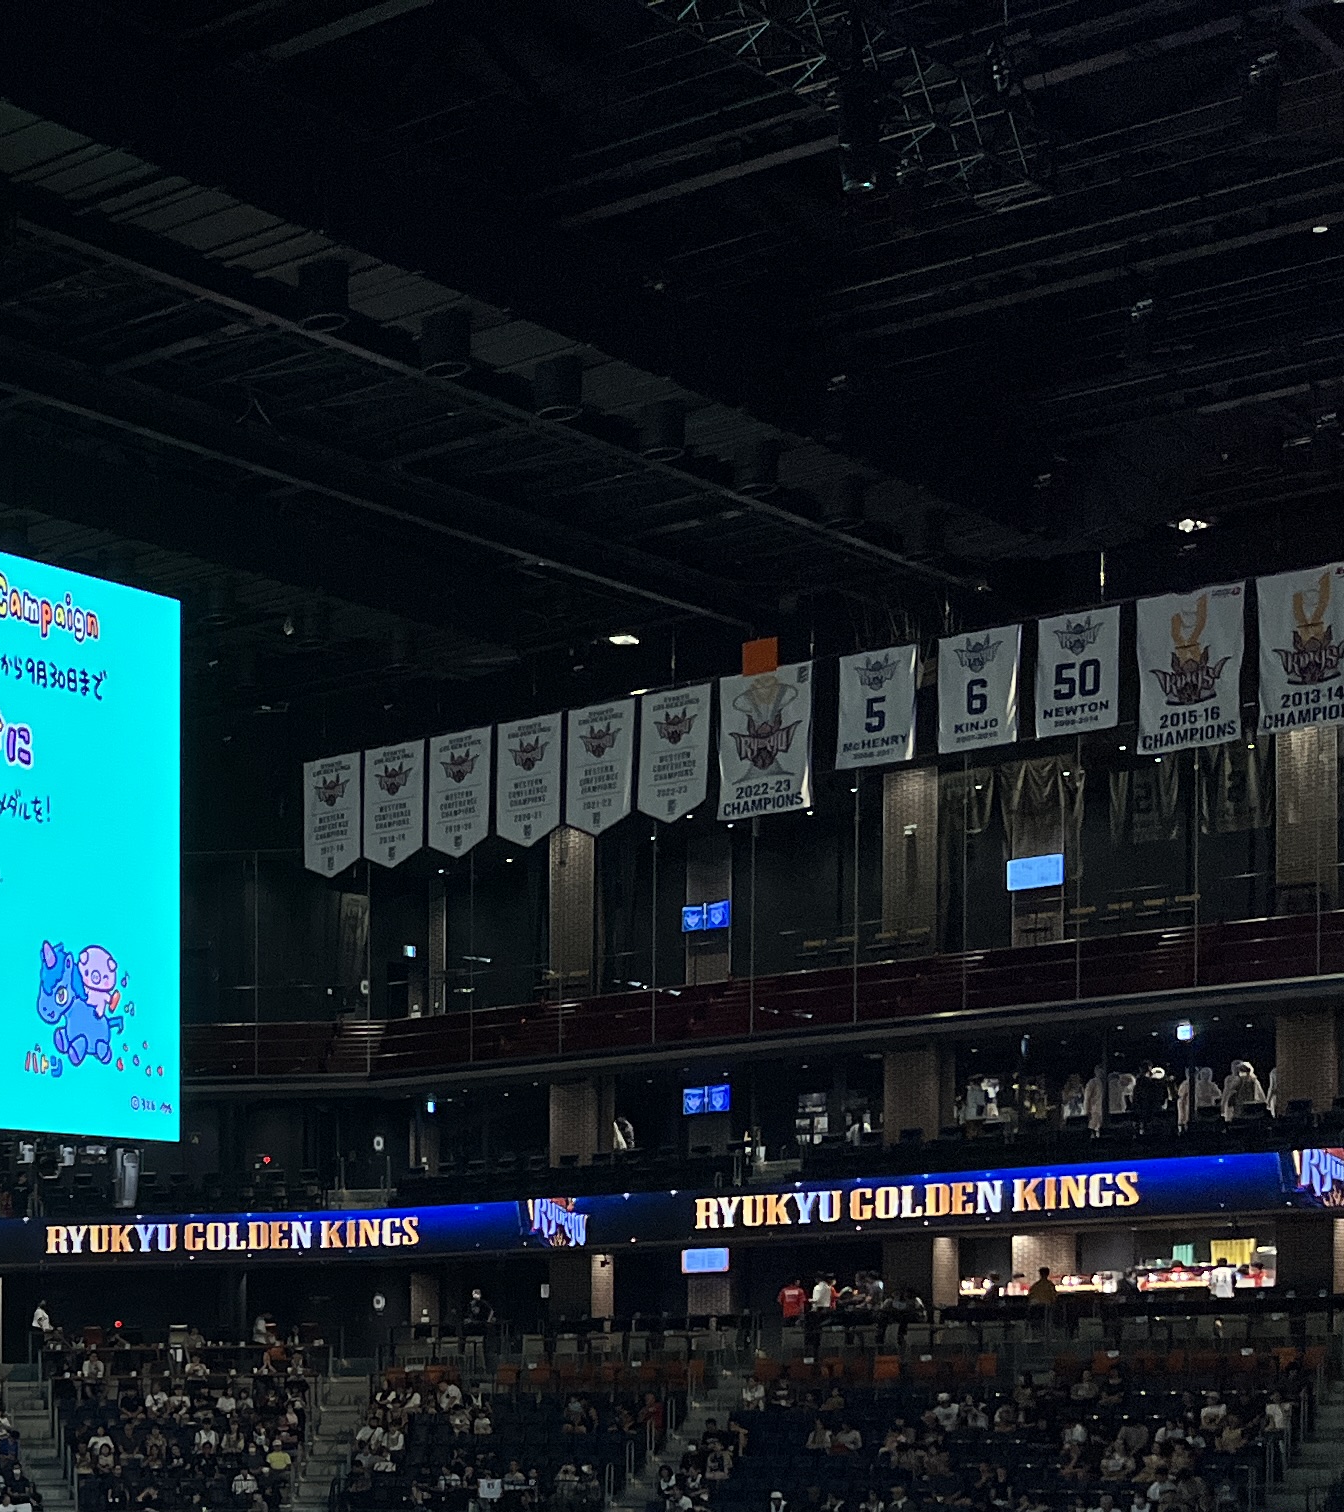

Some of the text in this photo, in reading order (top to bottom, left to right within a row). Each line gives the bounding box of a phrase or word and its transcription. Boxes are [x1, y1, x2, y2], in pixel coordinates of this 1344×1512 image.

[1053, 658, 1101, 701] 50
[966, 678, 988, 716] 6
[1281, 685, 1344, 709] 2013-14
[865, 696, 887, 733] 5
[1043, 700, 1110, 720] NEWTON
[1159, 706, 1220, 729] 2015-16
[954, 718, 999, 735] KINJO
[1141, 720, 1237, 750] CHAMPIONS
[842, 733, 908, 753] McHENRY
[735, 779, 791, 799] 2022-23
[723, 792, 804, 817] CHAMPIONS
[695, 1171, 1140, 1229] RYUKYU GOLDEN KINGS
[45, 1216, 420, 1254] RYUKYU GOLDEN KINGS
